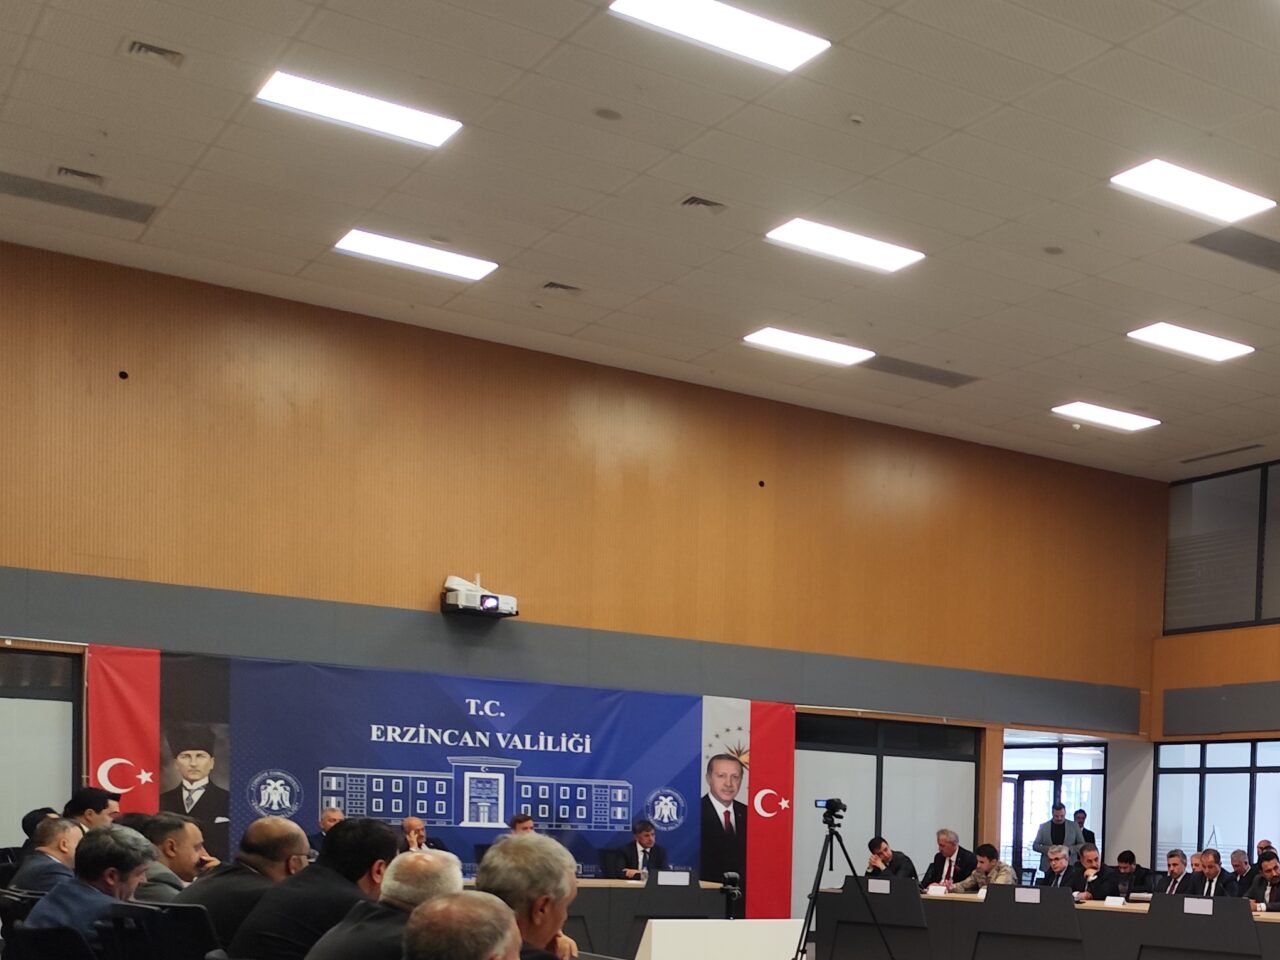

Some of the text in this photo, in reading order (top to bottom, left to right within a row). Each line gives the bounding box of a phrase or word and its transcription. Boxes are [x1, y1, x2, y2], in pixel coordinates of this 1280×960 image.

[466, 698, 506, 718] T.C.
[370, 723, 592, 753] ERZİNCAN VALİLİĞİ
